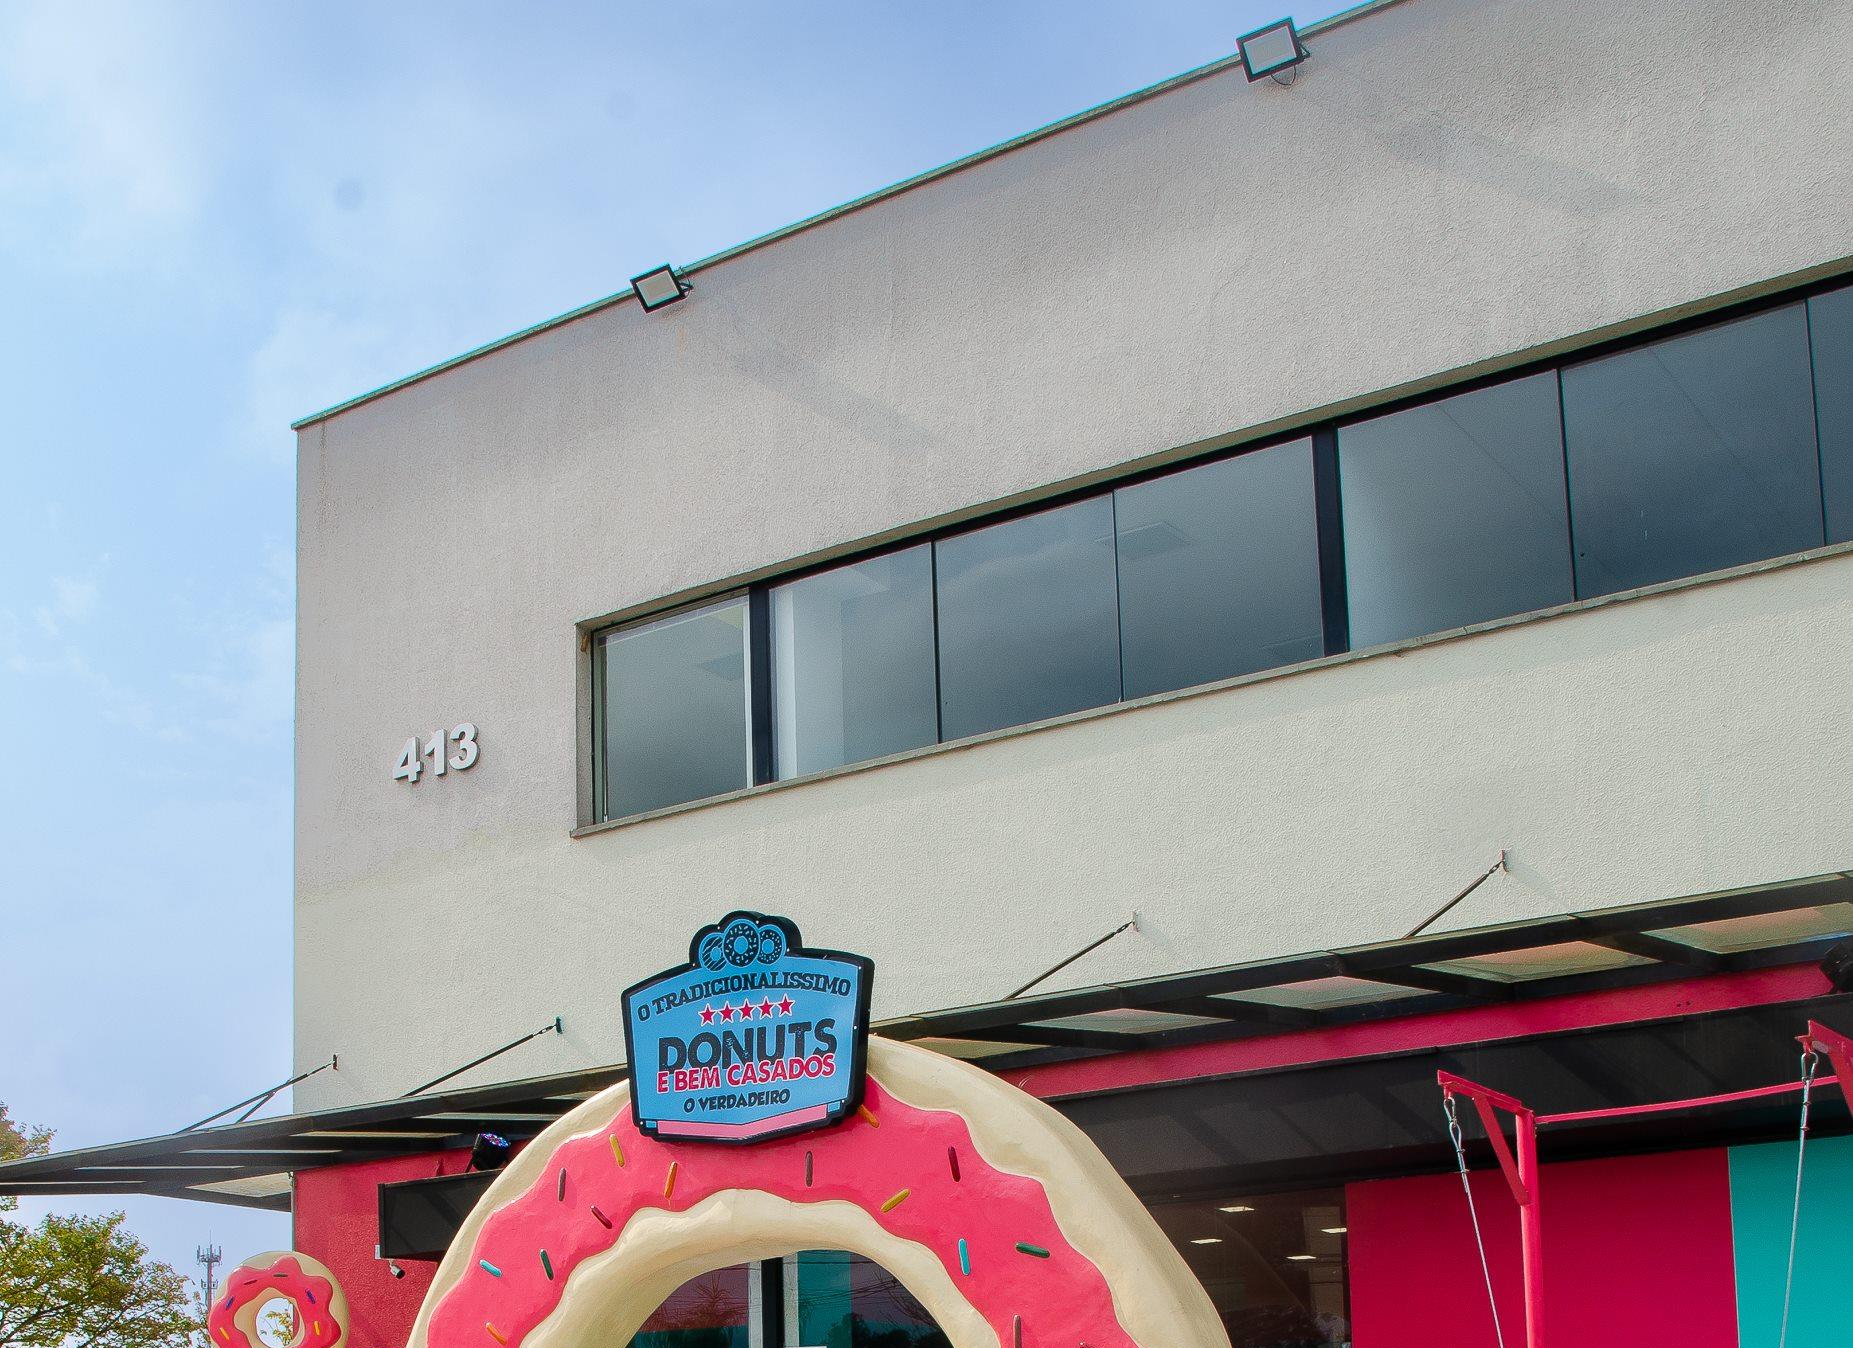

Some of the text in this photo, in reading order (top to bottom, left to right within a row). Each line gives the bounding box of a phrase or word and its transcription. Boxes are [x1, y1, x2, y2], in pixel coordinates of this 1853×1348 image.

[393, 722, 480, 784] 413
[637, 971, 851, 1021] O TRADICIONALISSIMO
[658, 1018, 838, 1076] DONUTS
[657, 1054, 836, 1093] E BEM CASADOS
[684, 1088, 791, 1114] O VERDADEIRO
